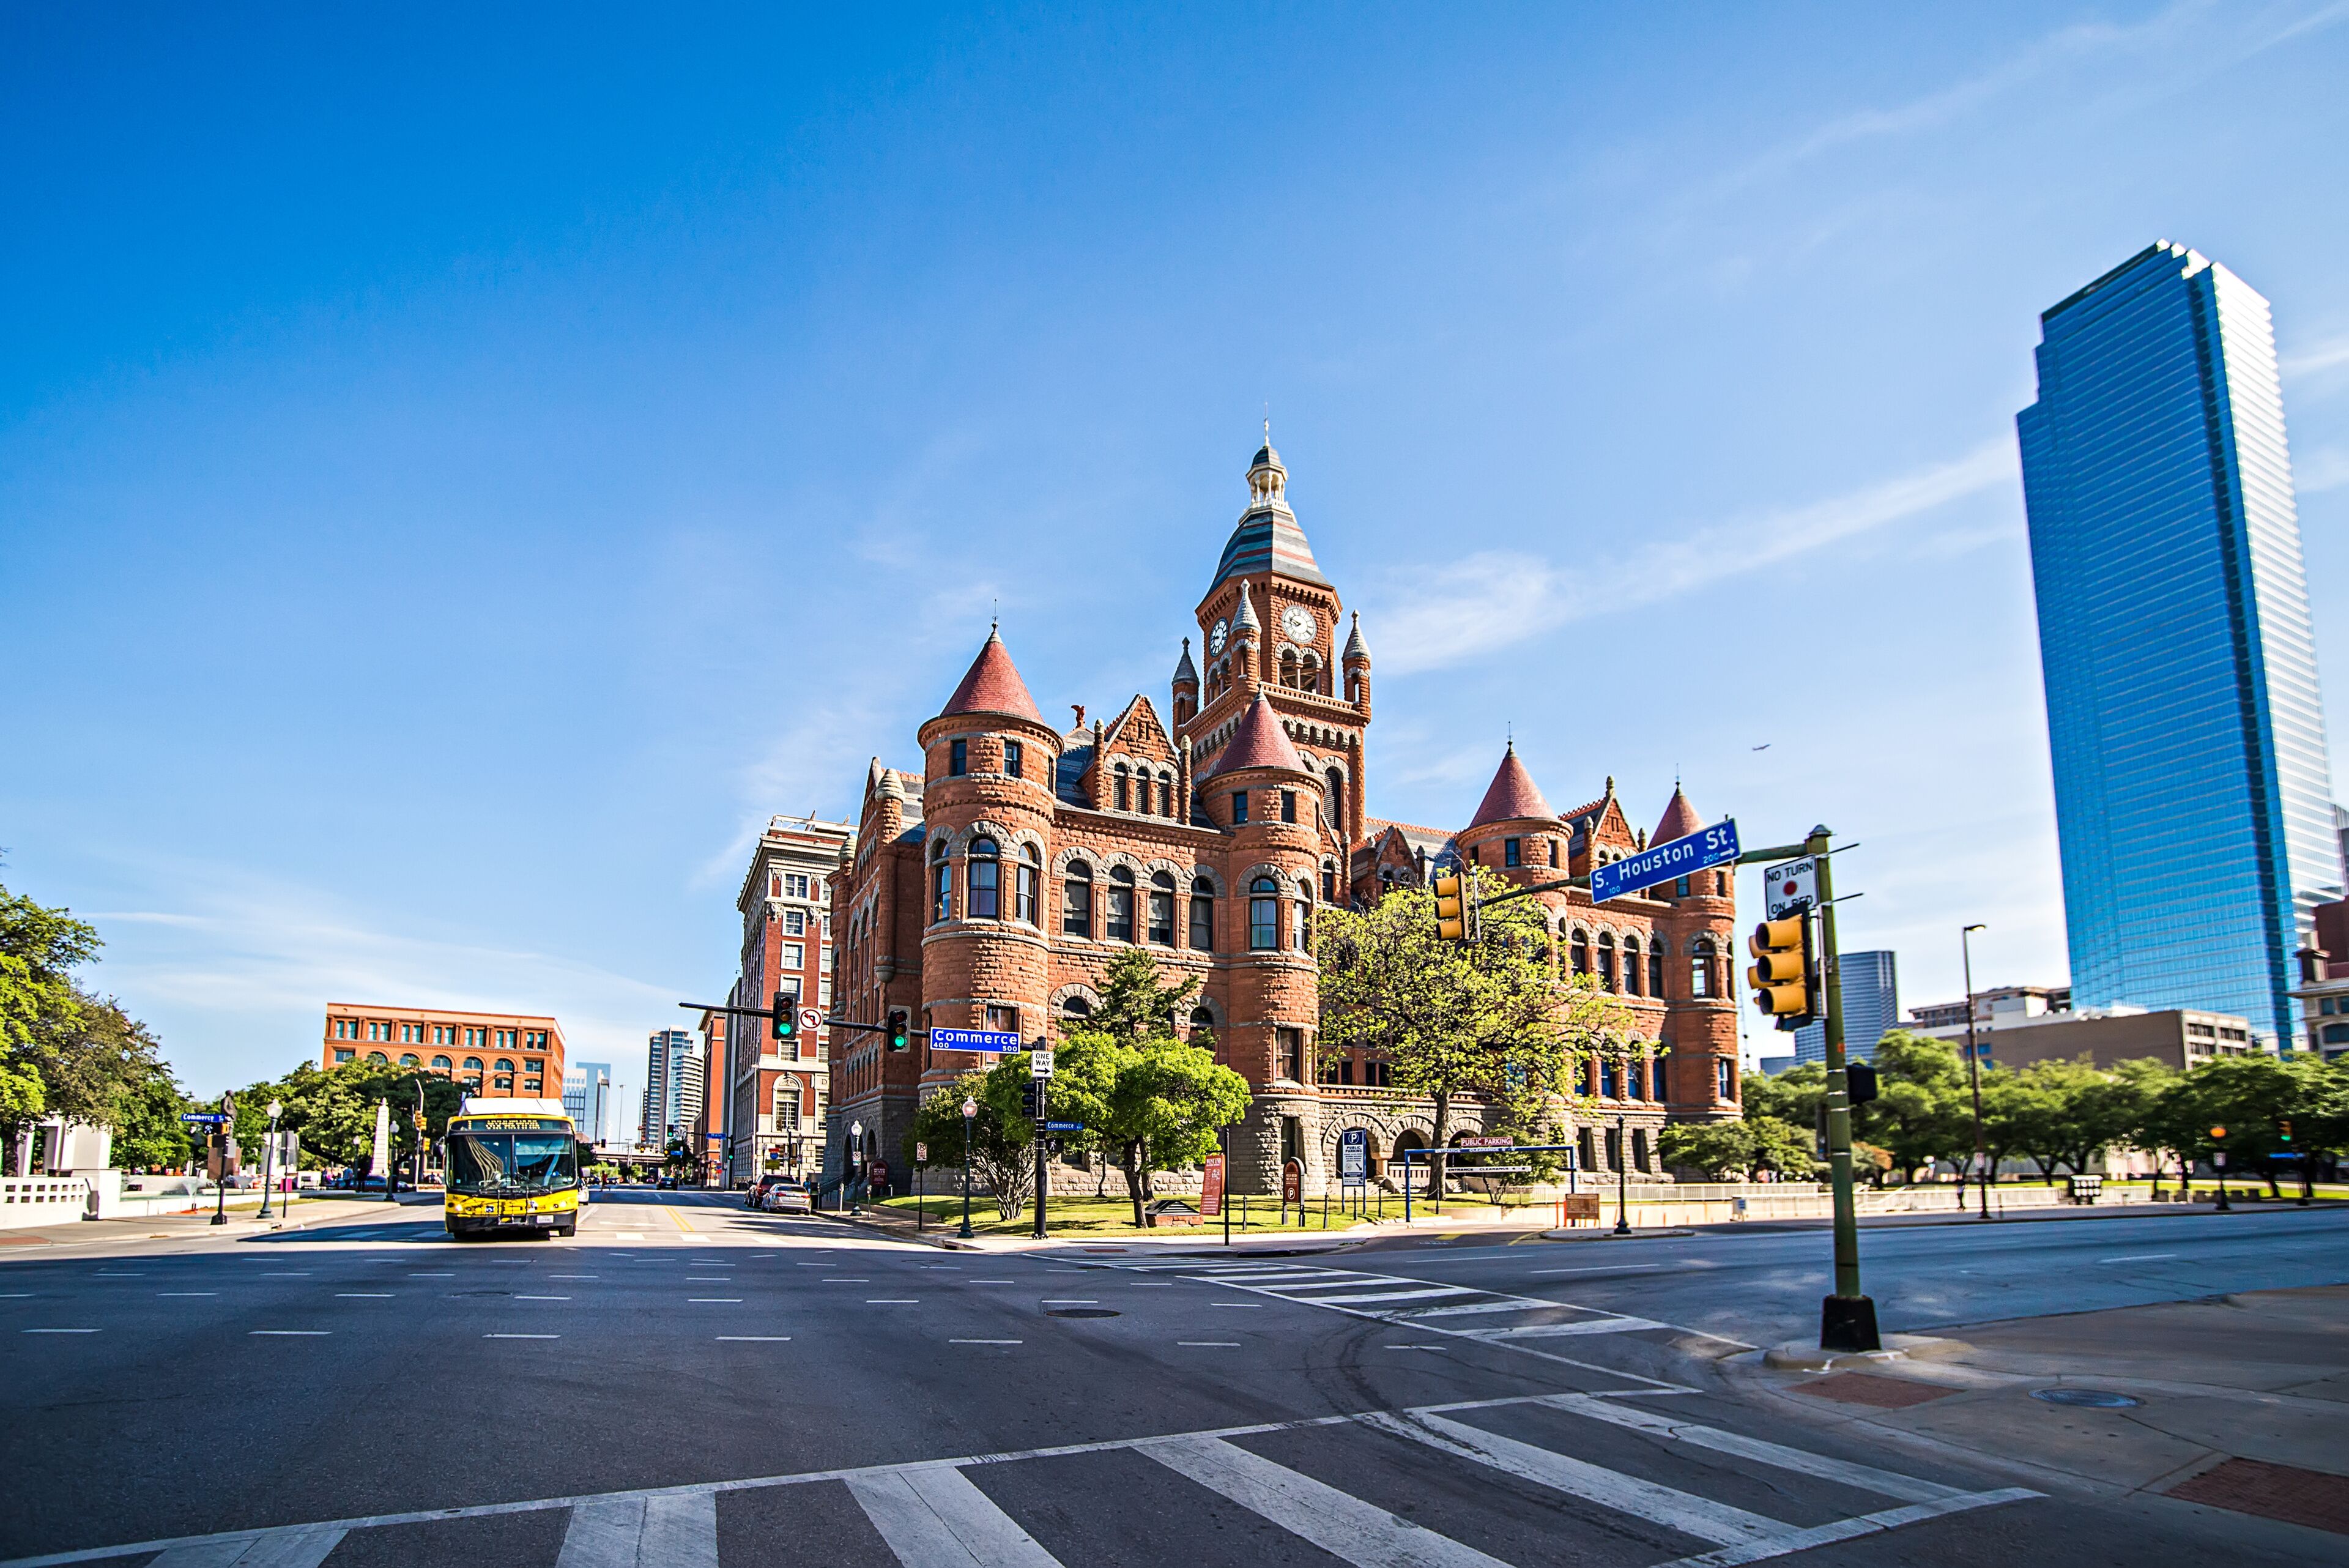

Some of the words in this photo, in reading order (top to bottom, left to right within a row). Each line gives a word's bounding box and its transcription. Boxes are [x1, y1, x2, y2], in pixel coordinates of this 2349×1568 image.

[1595, 871, 1609, 888] S.
[1619, 843, 1694, 880] Houston
[1705, 828, 1734, 850] St.
[1703, 852, 1720, 864] 200
[1767, 870, 1781, 883] NO
[1784, 860, 1813, 878] TURN
[1609, 885, 1620, 894] 100
[1771, 902, 1786, 914] ON
[935, 1030, 1017, 1046] Commerce
